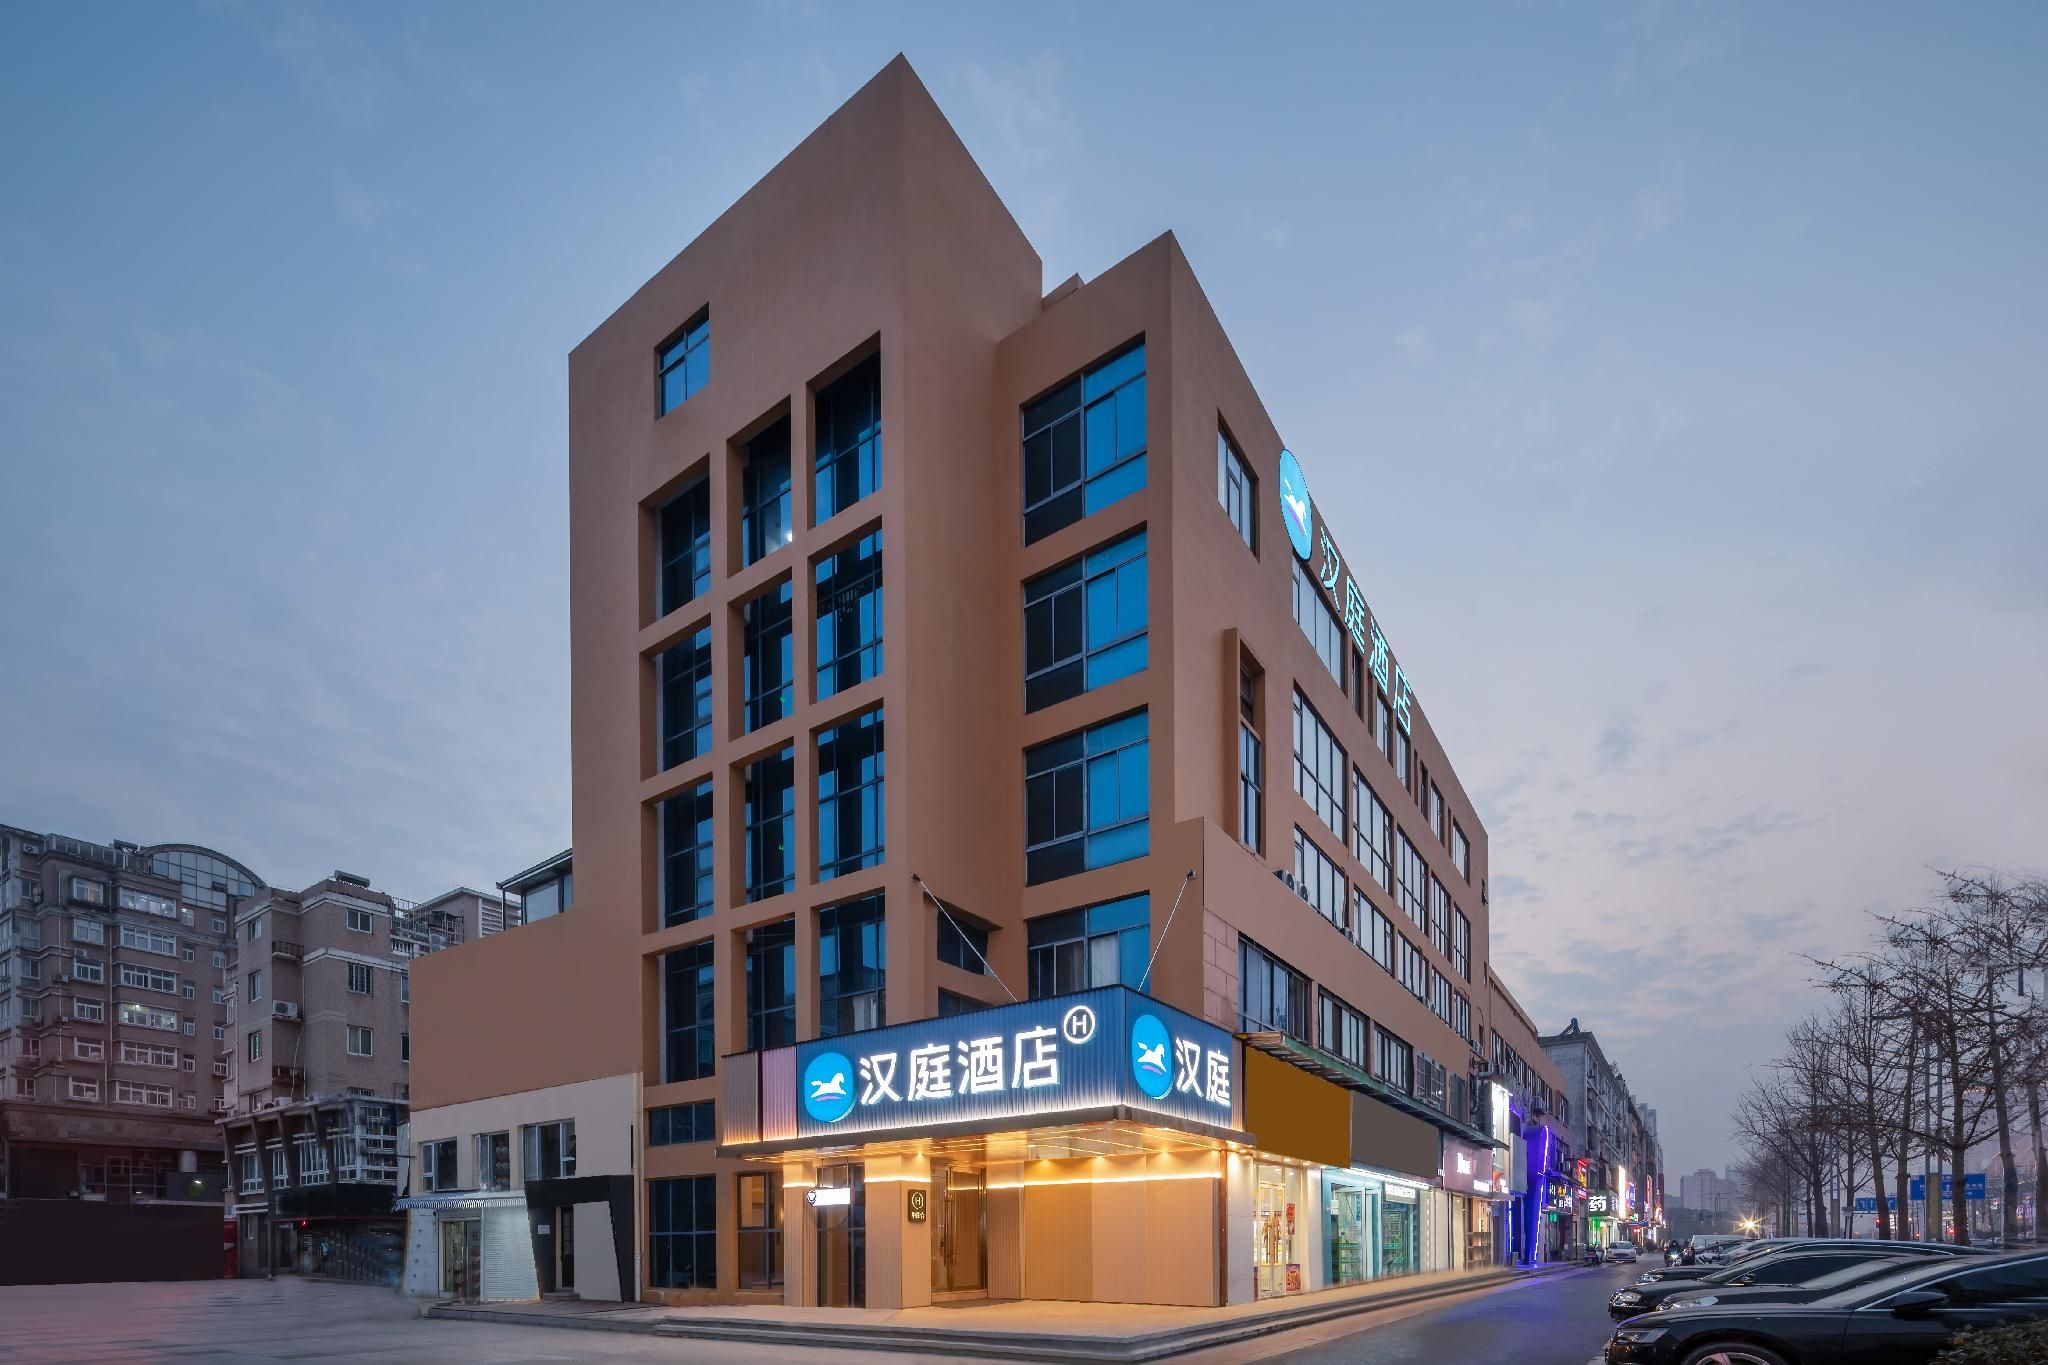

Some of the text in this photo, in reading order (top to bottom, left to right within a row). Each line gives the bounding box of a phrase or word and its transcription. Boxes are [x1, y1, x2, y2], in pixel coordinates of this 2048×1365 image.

[1320, 526, 1412, 736] 汉庭酒店
[859, 1026, 1059, 1105] 汉庭酒店
[1175, 1037, 1231, 1107] 汉庭
[1588, 1195, 1607, 1212] 药
